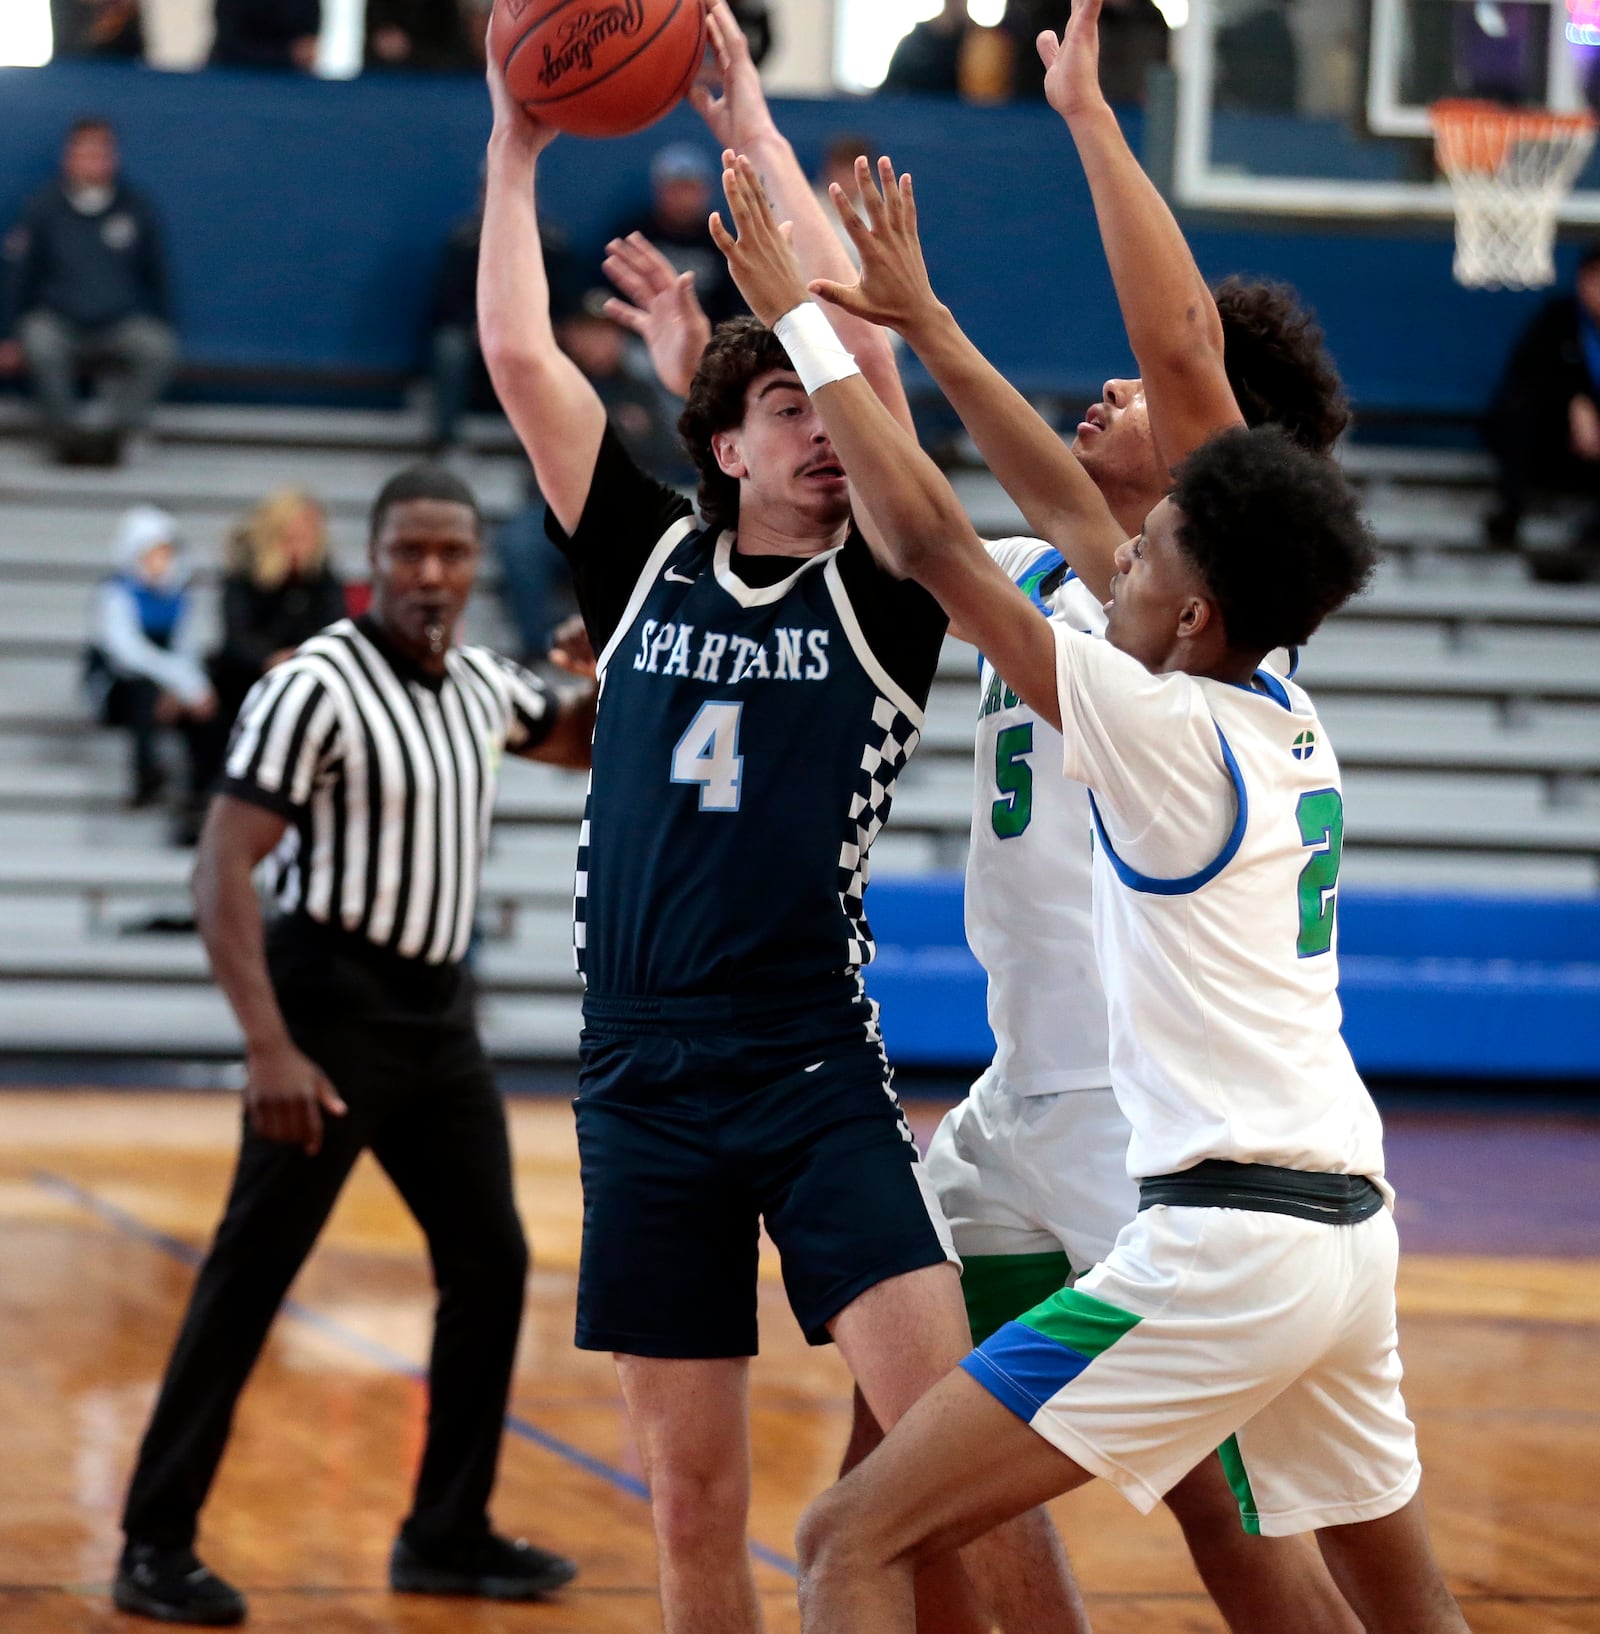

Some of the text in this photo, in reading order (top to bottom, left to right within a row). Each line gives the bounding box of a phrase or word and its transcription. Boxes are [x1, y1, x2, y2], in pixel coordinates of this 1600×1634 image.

[537, 0, 644, 87] Rawlings
[633, 619, 829, 685] SPARTANS
[669, 700, 744, 812] 4
[991, 721, 1034, 840] 5
[1296, 787, 1343, 959] 2
